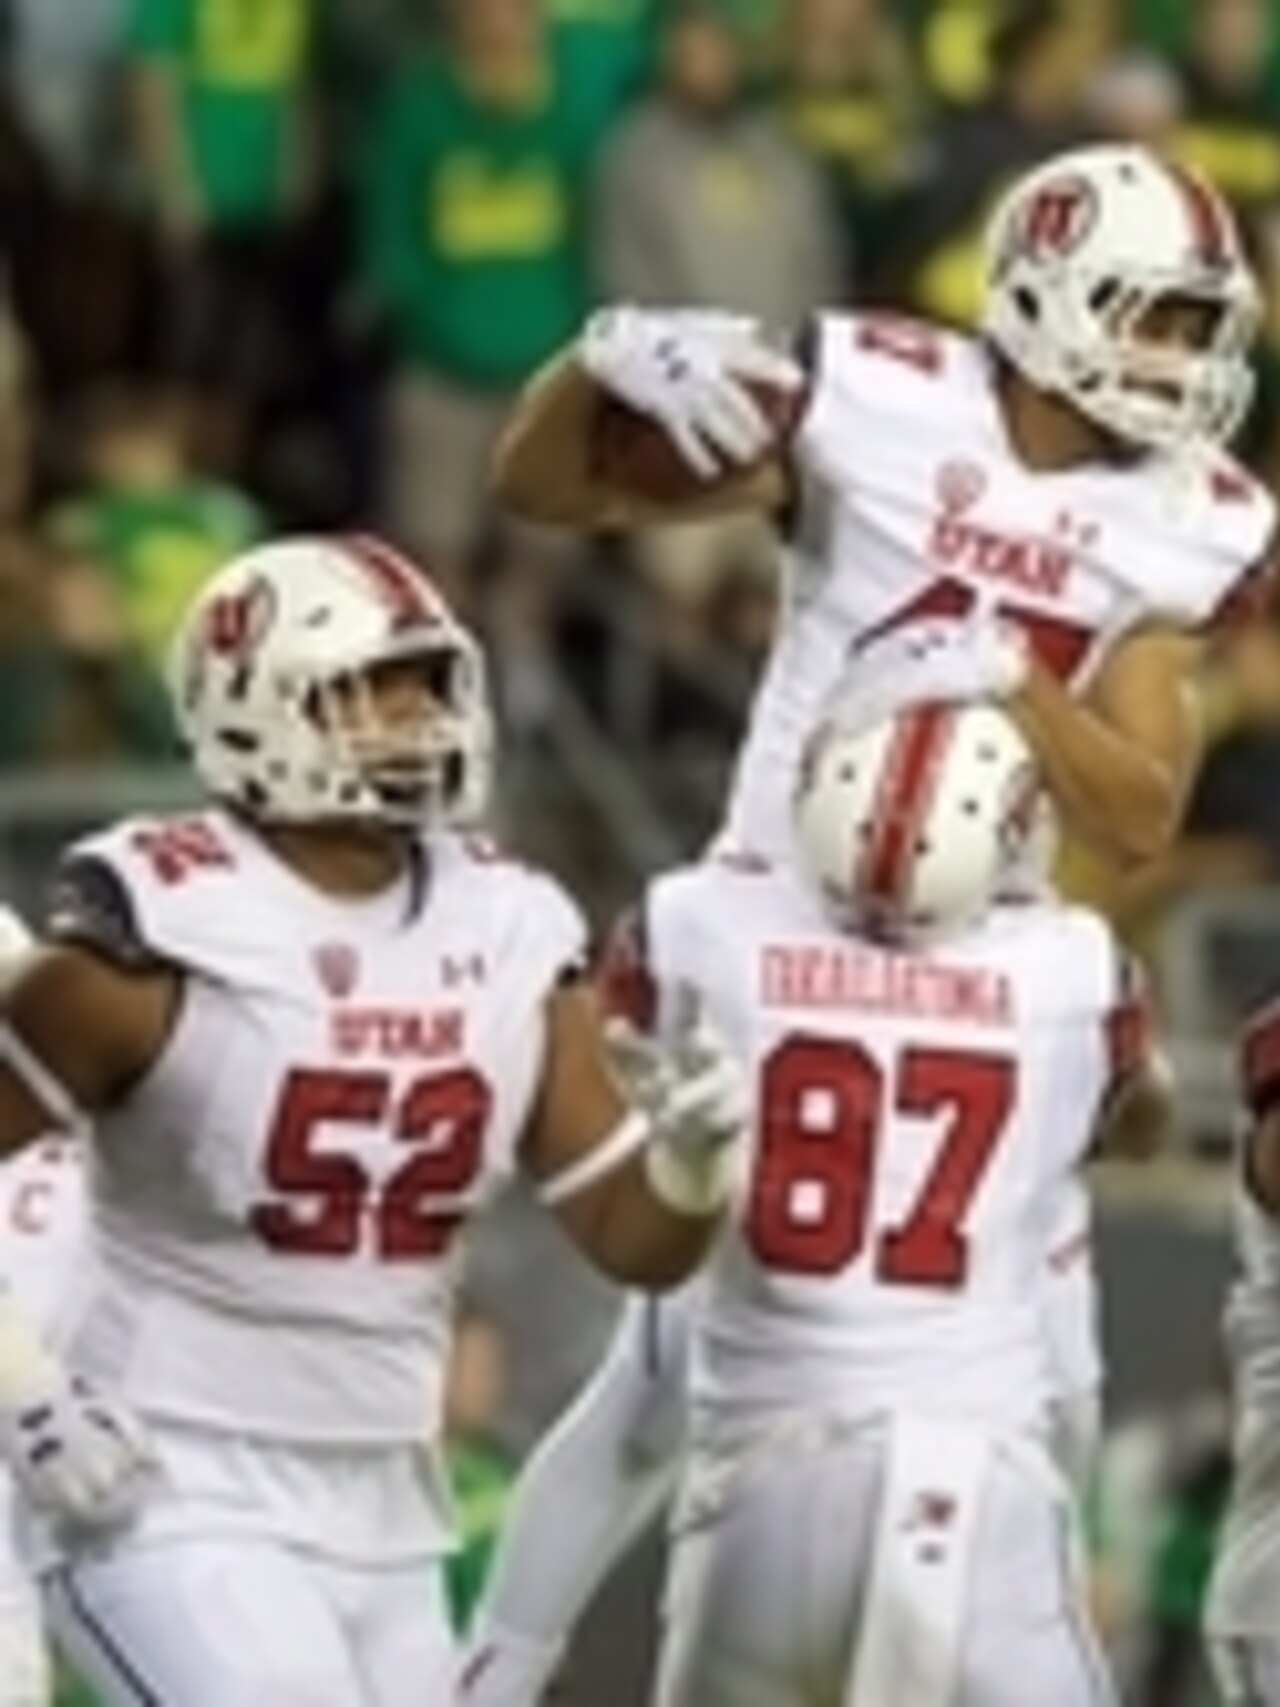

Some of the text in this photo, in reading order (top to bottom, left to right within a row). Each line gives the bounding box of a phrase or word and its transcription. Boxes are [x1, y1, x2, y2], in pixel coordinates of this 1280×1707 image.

[930, 514, 1073, 597] UTAH
[330, 1007, 466, 1058] UTAH
[246, 1063, 493, 1262] 52
[742, 1028, 1018, 1290] 87
[9, 1180, 54, 1237] C
